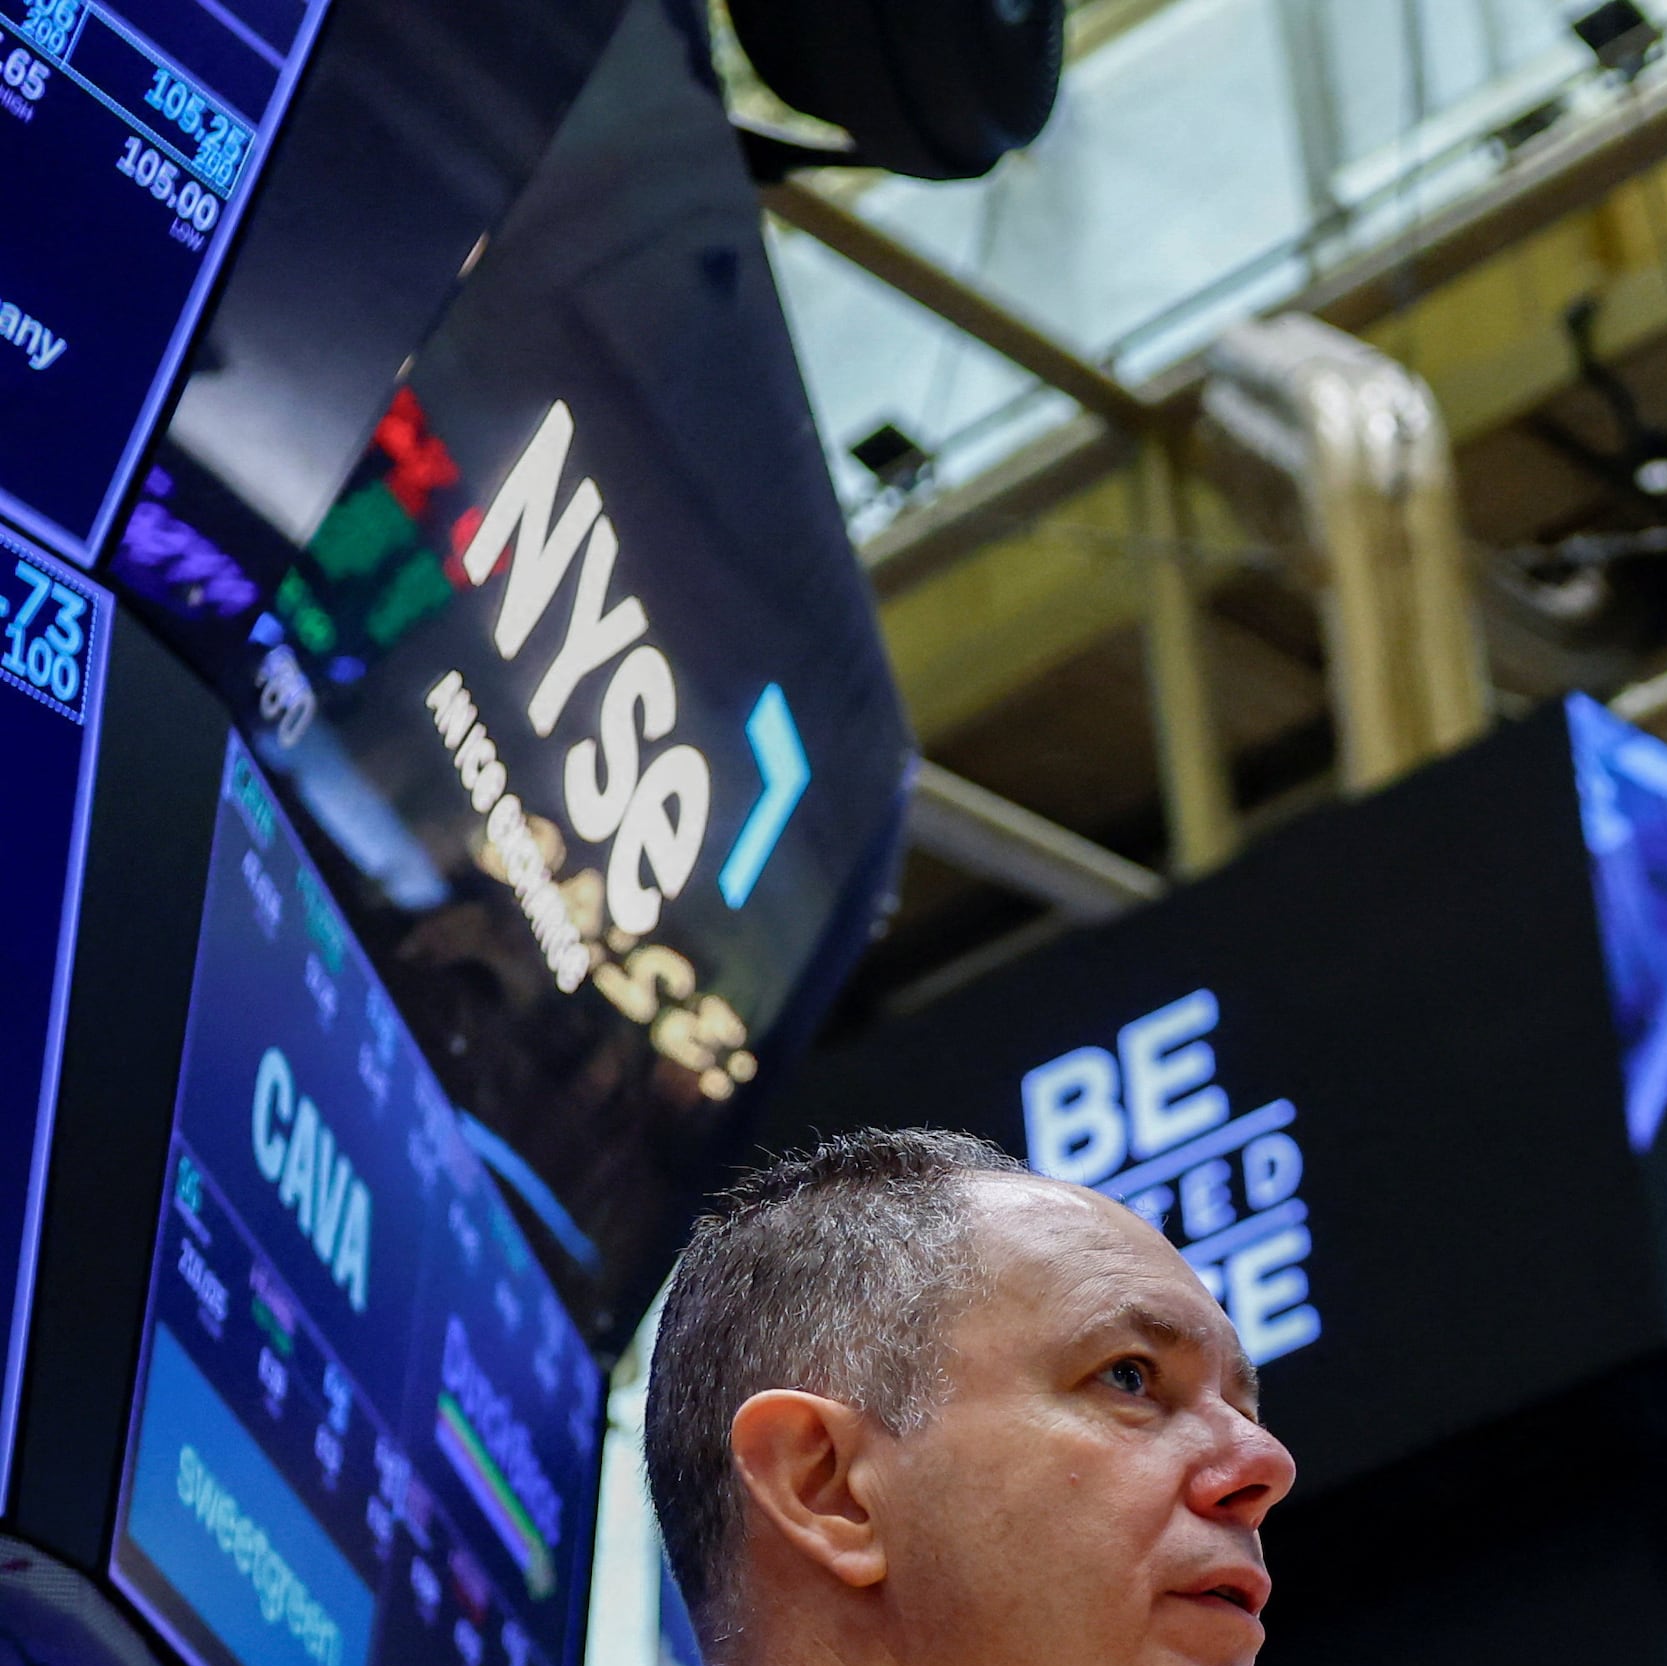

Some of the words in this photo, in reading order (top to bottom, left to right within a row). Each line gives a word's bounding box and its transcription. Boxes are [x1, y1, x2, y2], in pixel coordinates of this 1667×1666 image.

[144, 68, 249, 161] 105.25
[116, 136, 219, 232] 105.00
[169, 217, 205, 251] LOW
[1, 623, 80, 701] 100
[1021, 987, 1230, 1187] BE
[252, 1047, 373, 1312] CAVA
